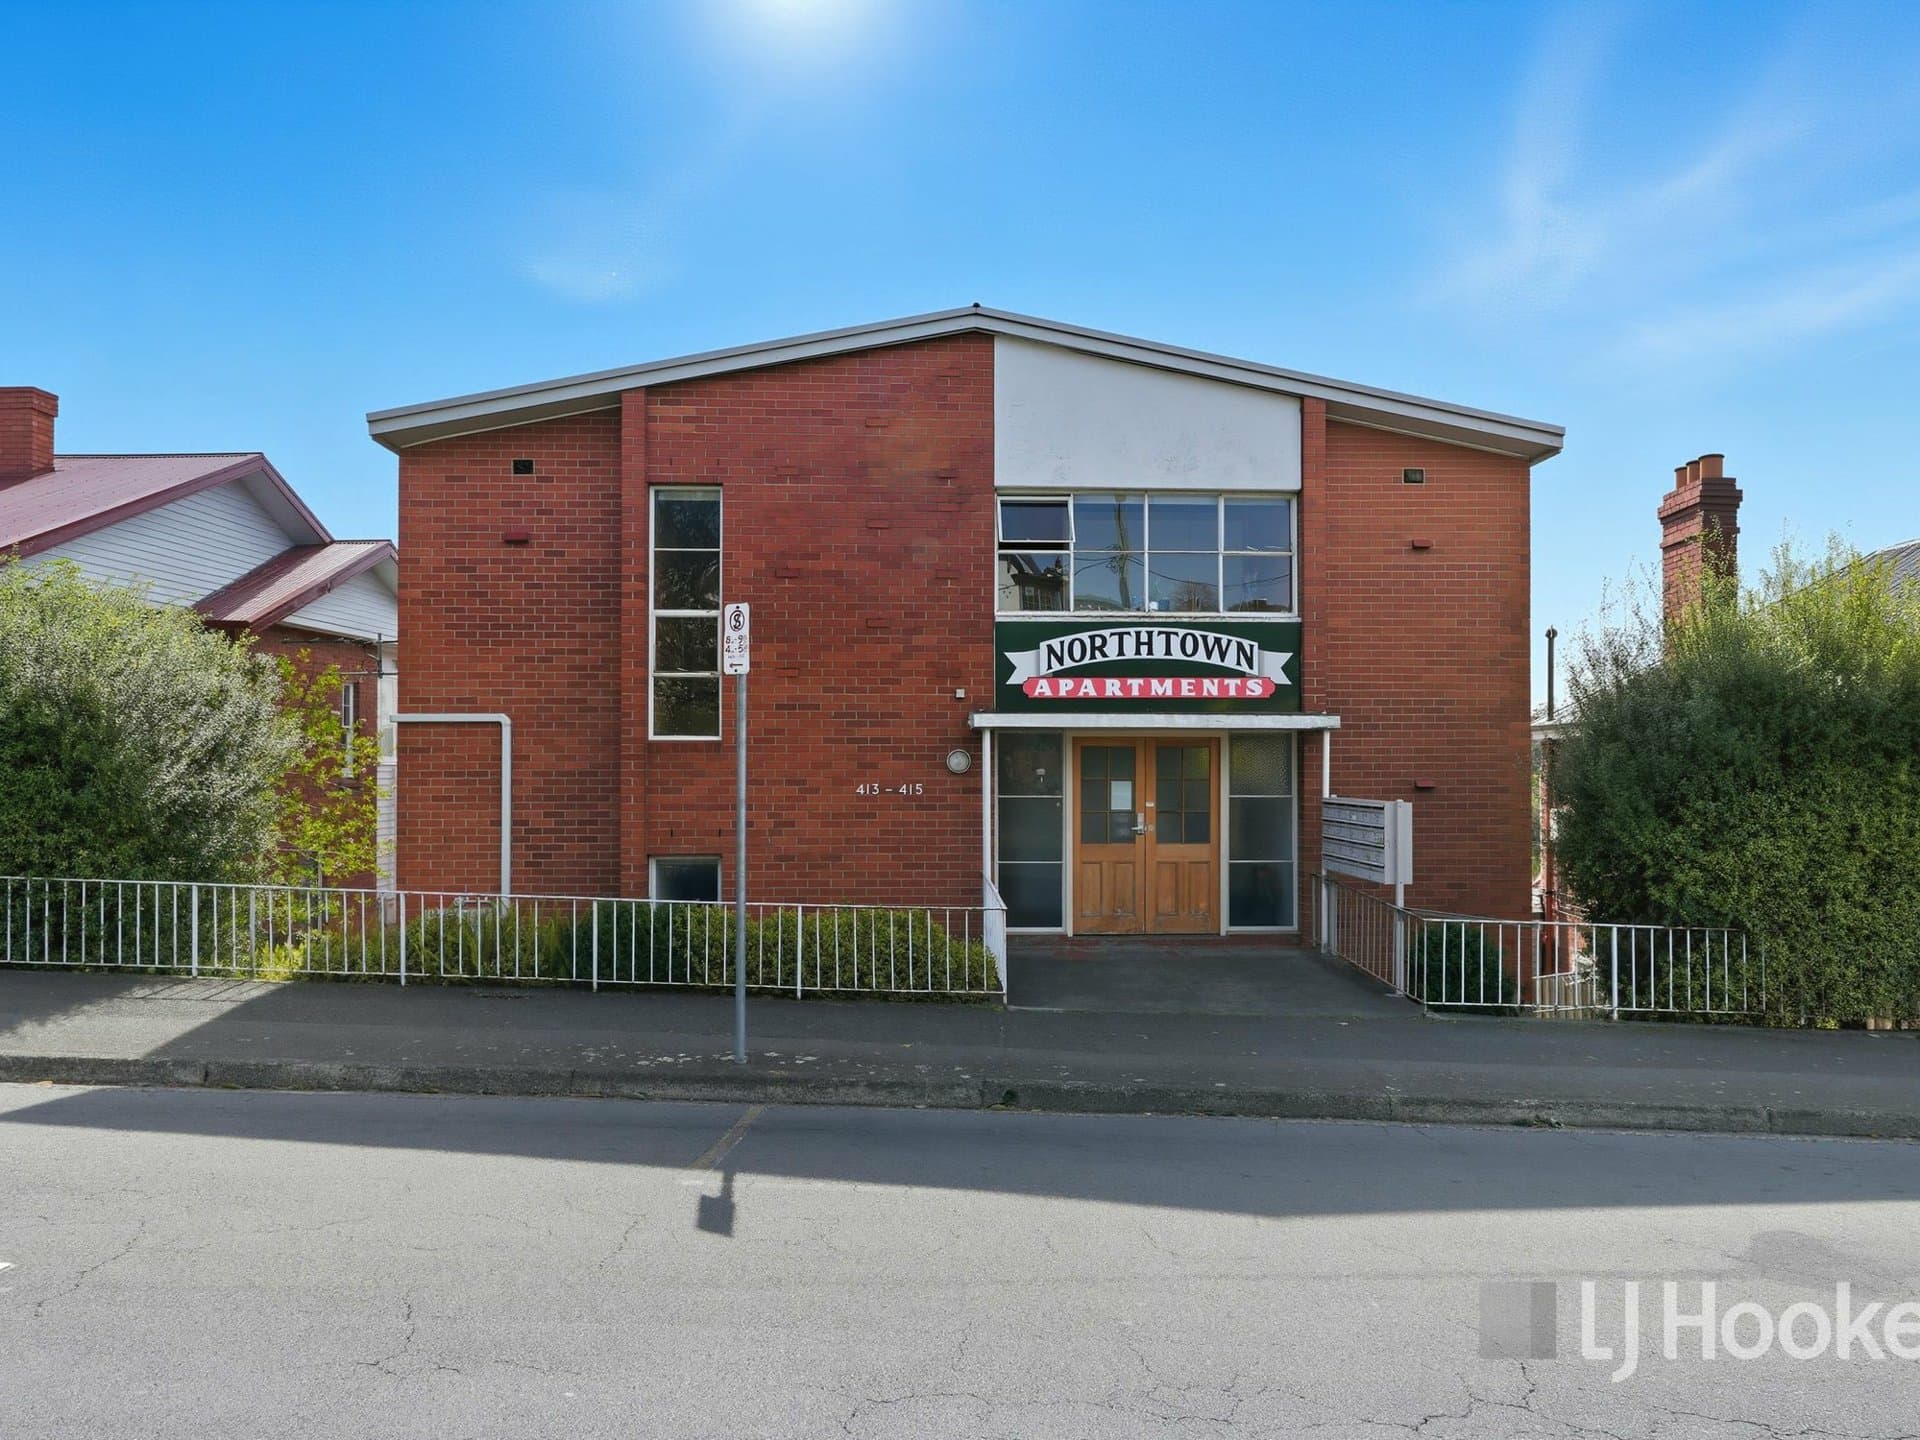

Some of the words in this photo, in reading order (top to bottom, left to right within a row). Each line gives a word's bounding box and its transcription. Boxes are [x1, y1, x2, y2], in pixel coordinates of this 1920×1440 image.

[1046, 630, 1254, 670] NORTHTOWN
[1034, 679, 1263, 697] APARTMENTS
[856, 784, 880, 795] 413
[899, 784, 923, 795] 415
